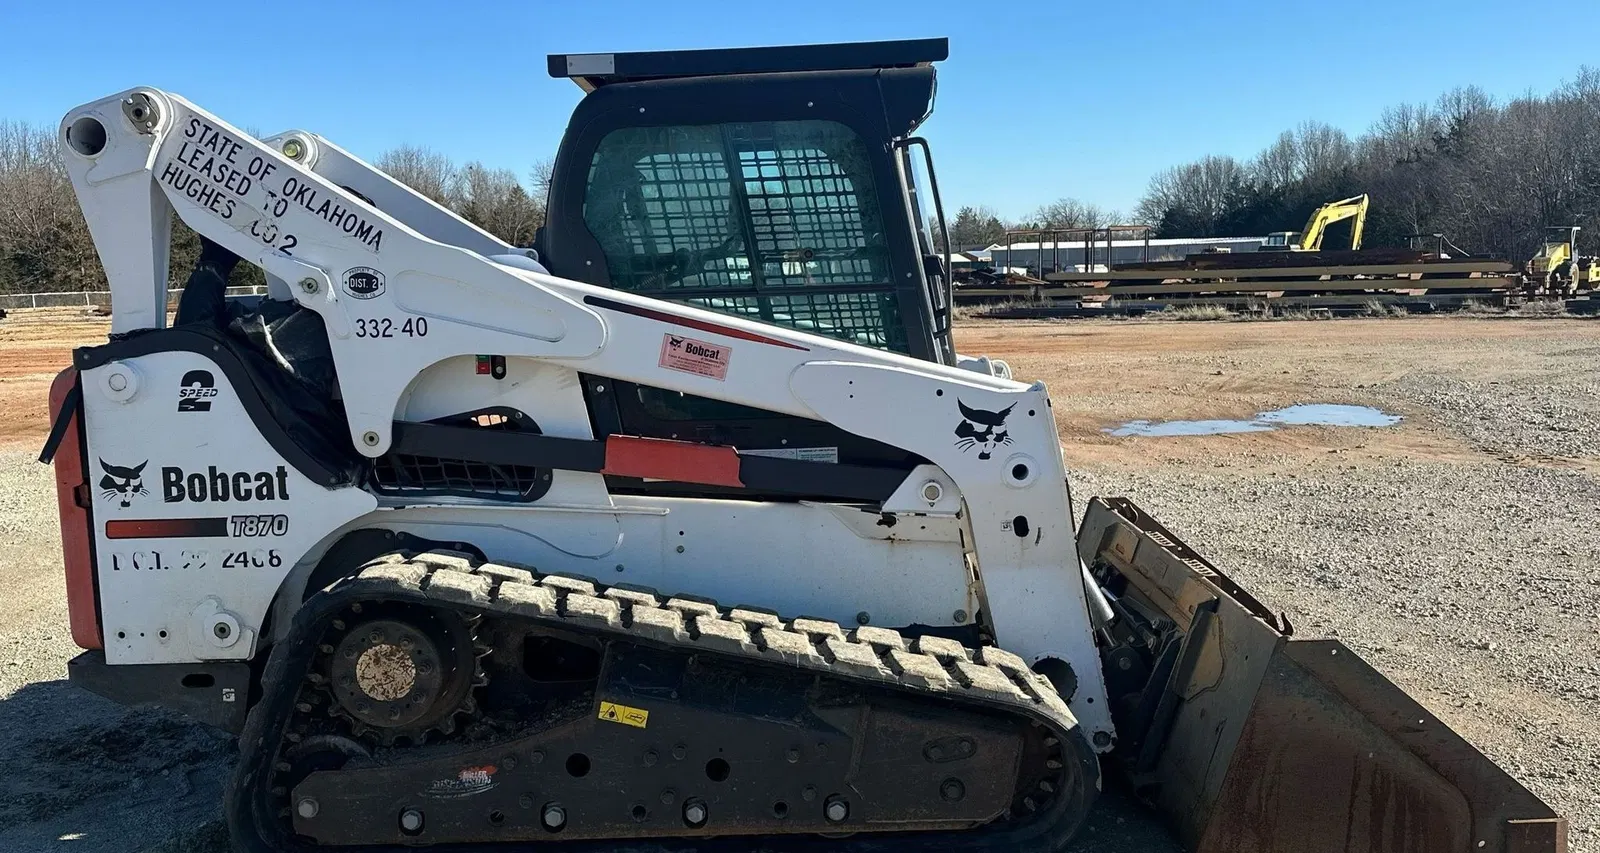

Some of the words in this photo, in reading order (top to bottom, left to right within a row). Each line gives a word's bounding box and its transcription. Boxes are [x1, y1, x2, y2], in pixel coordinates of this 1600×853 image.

[160, 162, 236, 219] HUGHES
[177, 142, 251, 196] LEASED
[263, 190, 288, 217] TO
[184, 118, 243, 165] STATE
[248, 156, 277, 181] OF
[282, 177, 383, 251] OKLAHOMA
[350, 277, 369, 288] DIST.
[372, 279, 377, 288] 2
[356, 317, 428, 338] 332-40
[685, 343, 720, 359] Bobcat
[177, 369, 215, 412] 2
[179, 388, 218, 398] SPEED
[161, 465, 290, 503] Bobcat
[230, 514, 289, 538] T870
